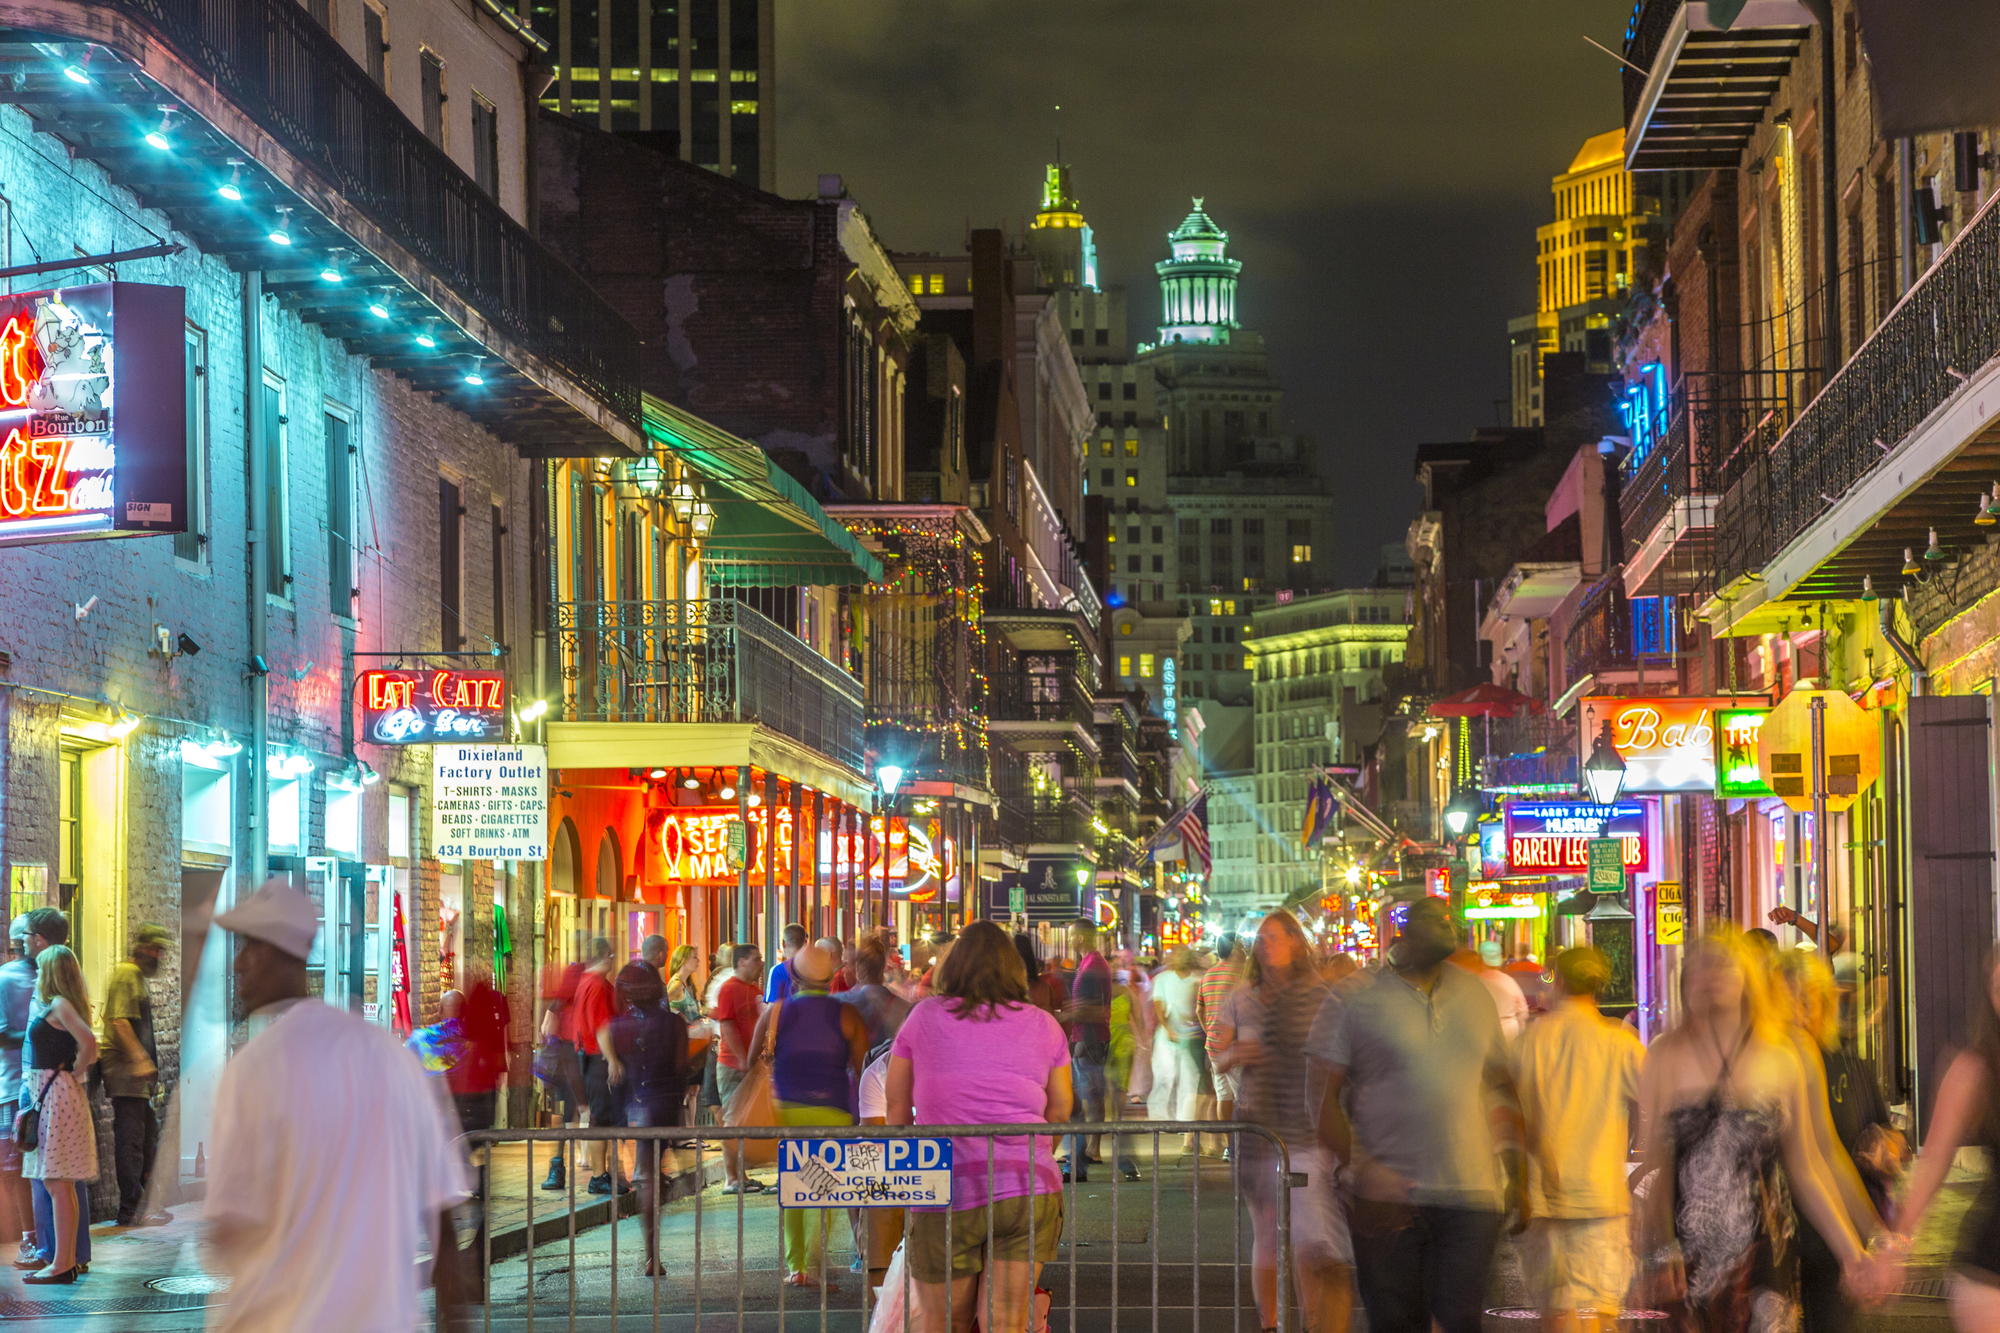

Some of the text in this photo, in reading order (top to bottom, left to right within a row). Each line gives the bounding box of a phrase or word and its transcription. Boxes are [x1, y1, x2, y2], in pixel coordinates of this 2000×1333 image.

[33, 418, 107, 436] Bourbon
[126, 503, 151, 512] SIGN
[1163, 657, 1176, 724] ASTOR
[434, 709, 481, 733] Bar
[459, 749, 523, 761] Dixieland
[440, 766, 541, 780] Factory Outlet
[443, 786, 537, 796] T-SHIRTS MASKS
[438, 800, 543, 810] CAMERAS GIFTS CAPS
[1534, 808, 1569, 817] LARRY
[442, 814, 538, 824] BEADS CIGARETTES
[450, 828, 529, 838] SOFT DRINKS ATM
[438, 845, 542, 856] 434 Bourbon St
[1513, 837, 1641, 866] BARELY LEG UB
[1534, 883, 1552, 892] MEX
[1556, 879, 1583, 890] GRILL
[883, 1176, 922, 1186] LINE
[795, 1191, 936, 1201] DO NOT CROSS
